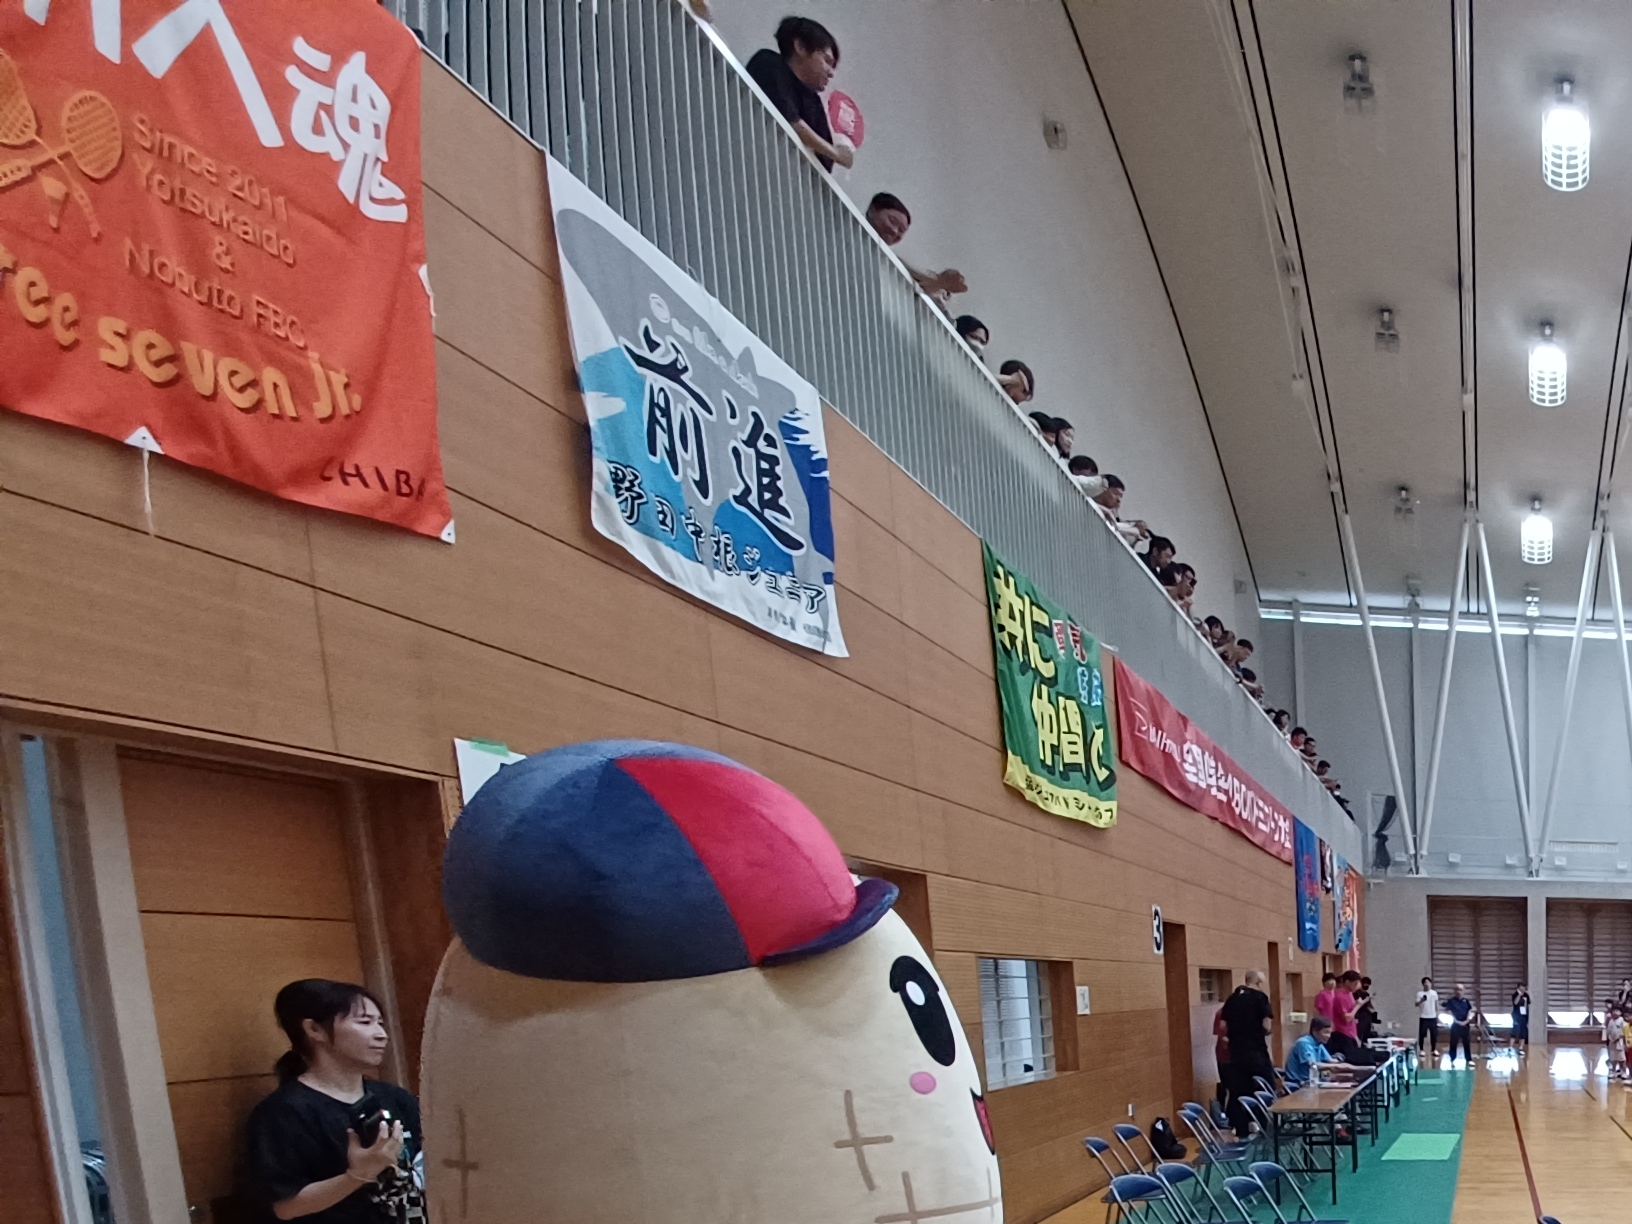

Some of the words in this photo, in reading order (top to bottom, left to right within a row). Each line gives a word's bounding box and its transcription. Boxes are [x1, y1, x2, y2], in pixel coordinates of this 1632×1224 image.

[131, 152, 296, 268] Yotsukaido
[132, 113, 219, 185] Since
[227, 165, 289, 223] 2011
[213, 236, 235, 274] &
[99, 315, 299, 420] seven
[621, 319, 806, 554] 前進
[605, 459, 827, 614] 野田中根ジュニア
[1153, 908, 1162, 952] 3
